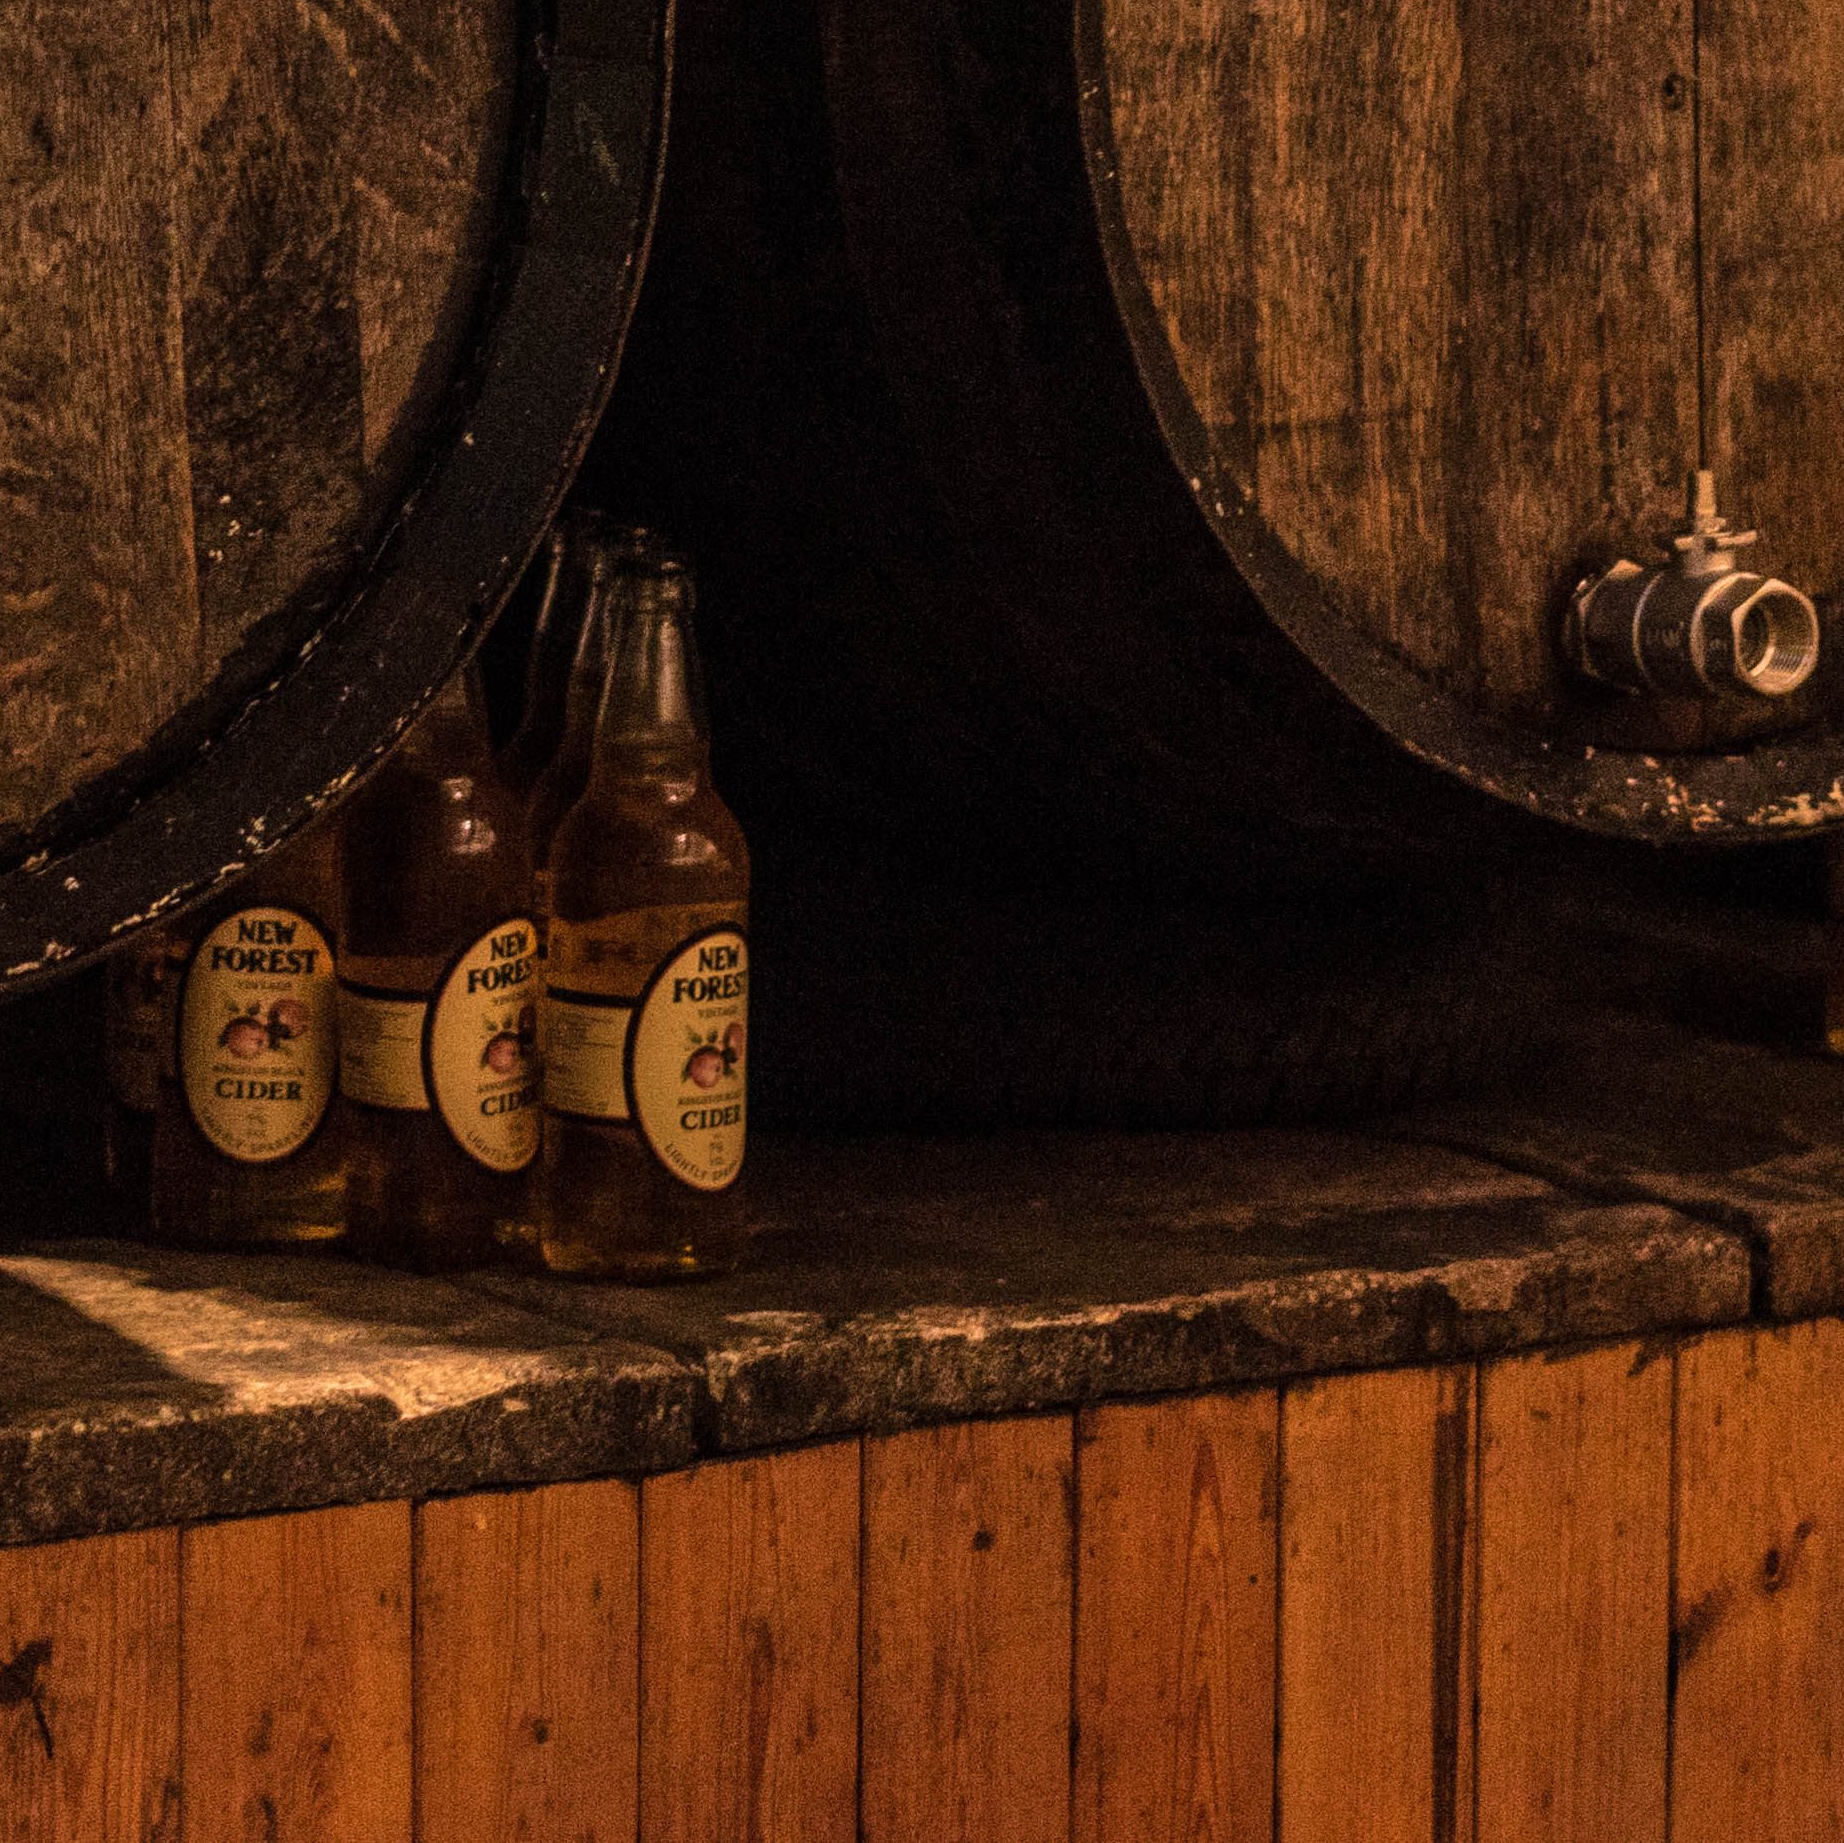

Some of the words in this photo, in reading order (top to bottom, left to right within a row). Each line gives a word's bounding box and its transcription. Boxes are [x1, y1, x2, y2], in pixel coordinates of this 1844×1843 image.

[238, 918, 297, 945] NEW
[209, 944, 319, 975] FOREST
[698, 943, 741, 973] NEW
[214, 1077, 303, 1101] CIDER
